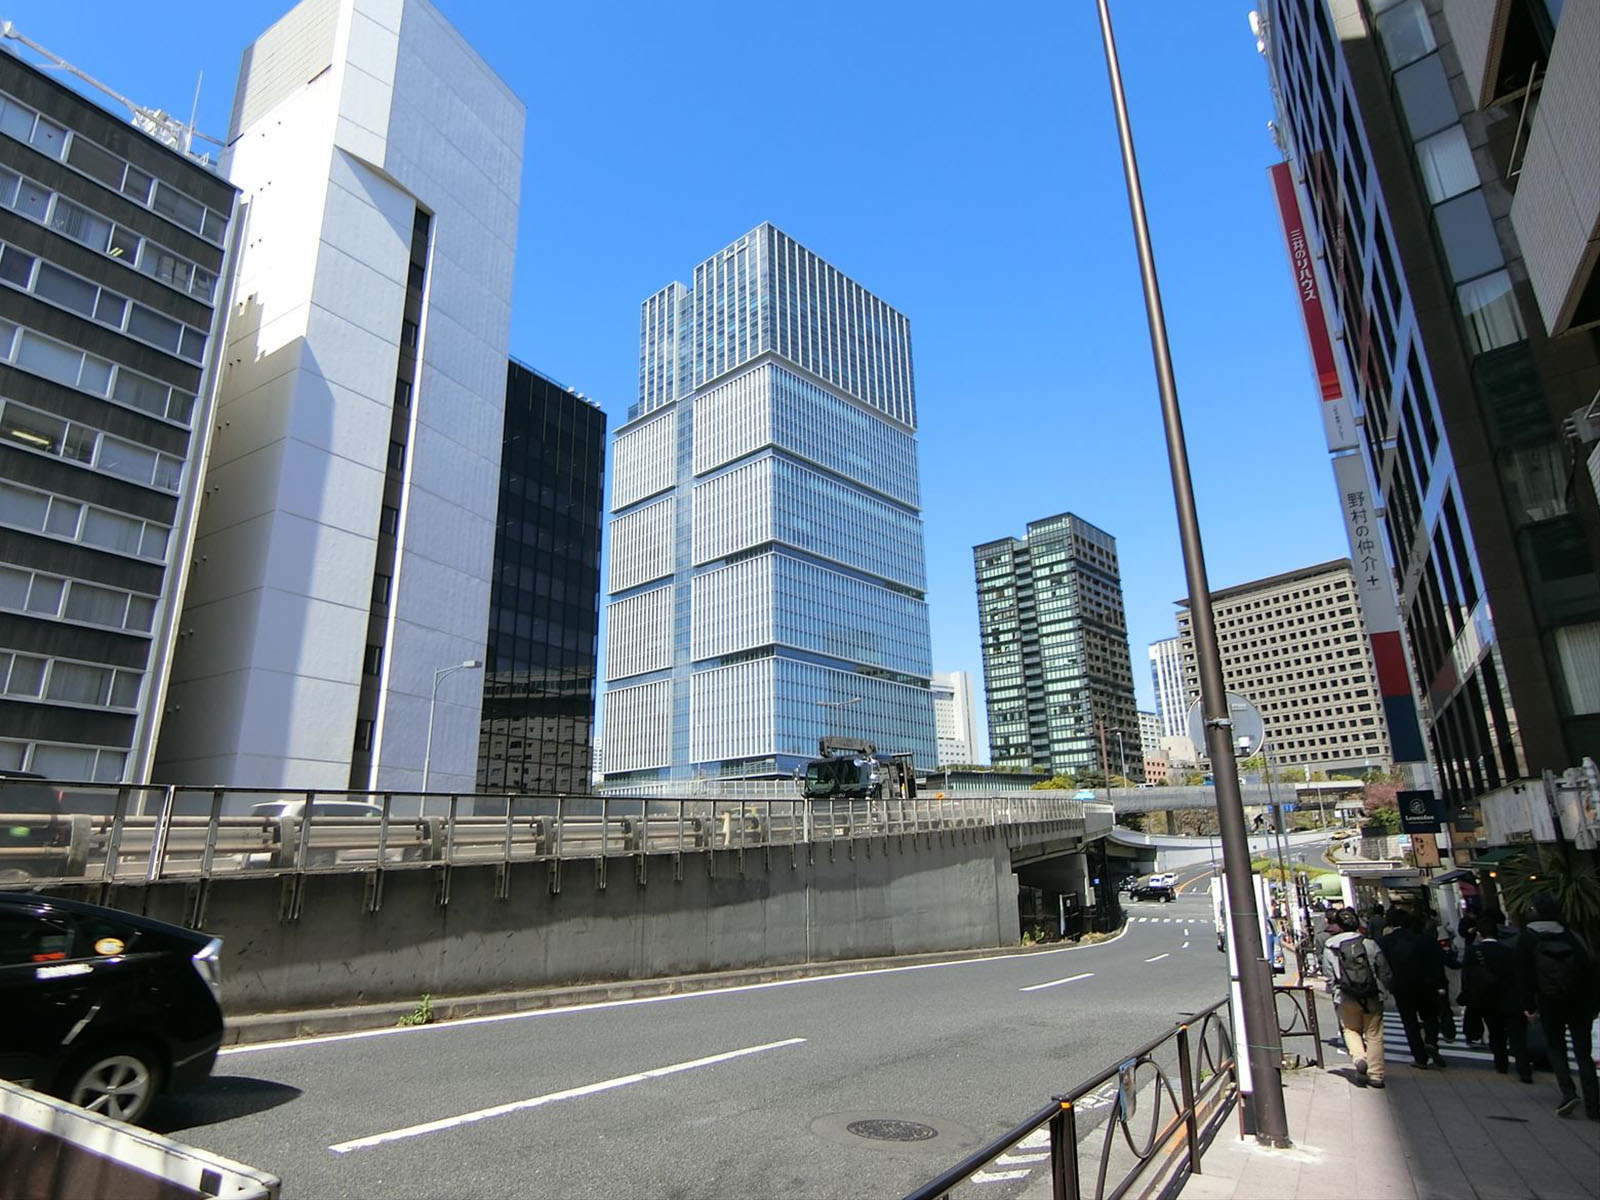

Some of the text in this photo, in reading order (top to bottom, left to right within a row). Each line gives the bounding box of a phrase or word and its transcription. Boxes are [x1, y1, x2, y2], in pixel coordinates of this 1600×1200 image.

[1290, 229, 1317, 302] 三井のリハウス
